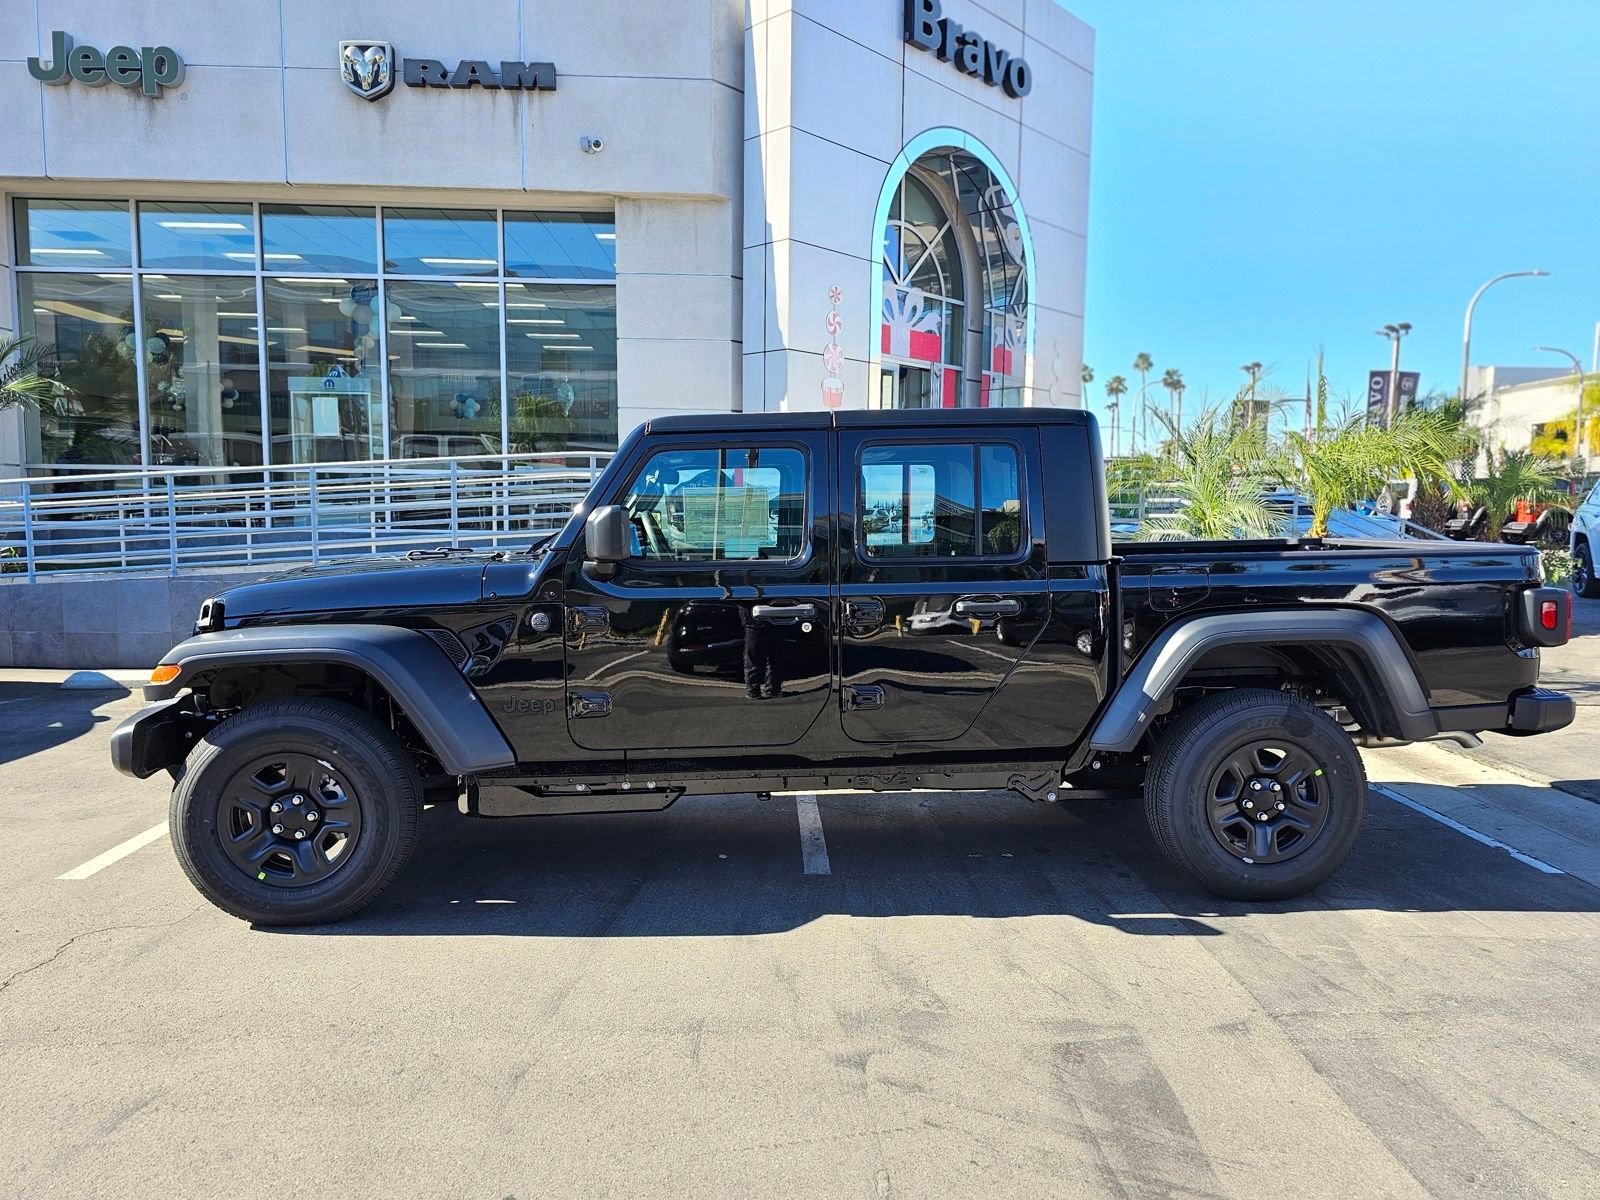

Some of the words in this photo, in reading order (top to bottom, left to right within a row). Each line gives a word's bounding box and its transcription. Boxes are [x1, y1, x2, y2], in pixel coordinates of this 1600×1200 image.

[27, 30, 184, 97] Jeep
[403, 58, 556, 91] RAM
[904, 0, 1032, 99] Bravo
[503, 695, 555, 714] Jeep
